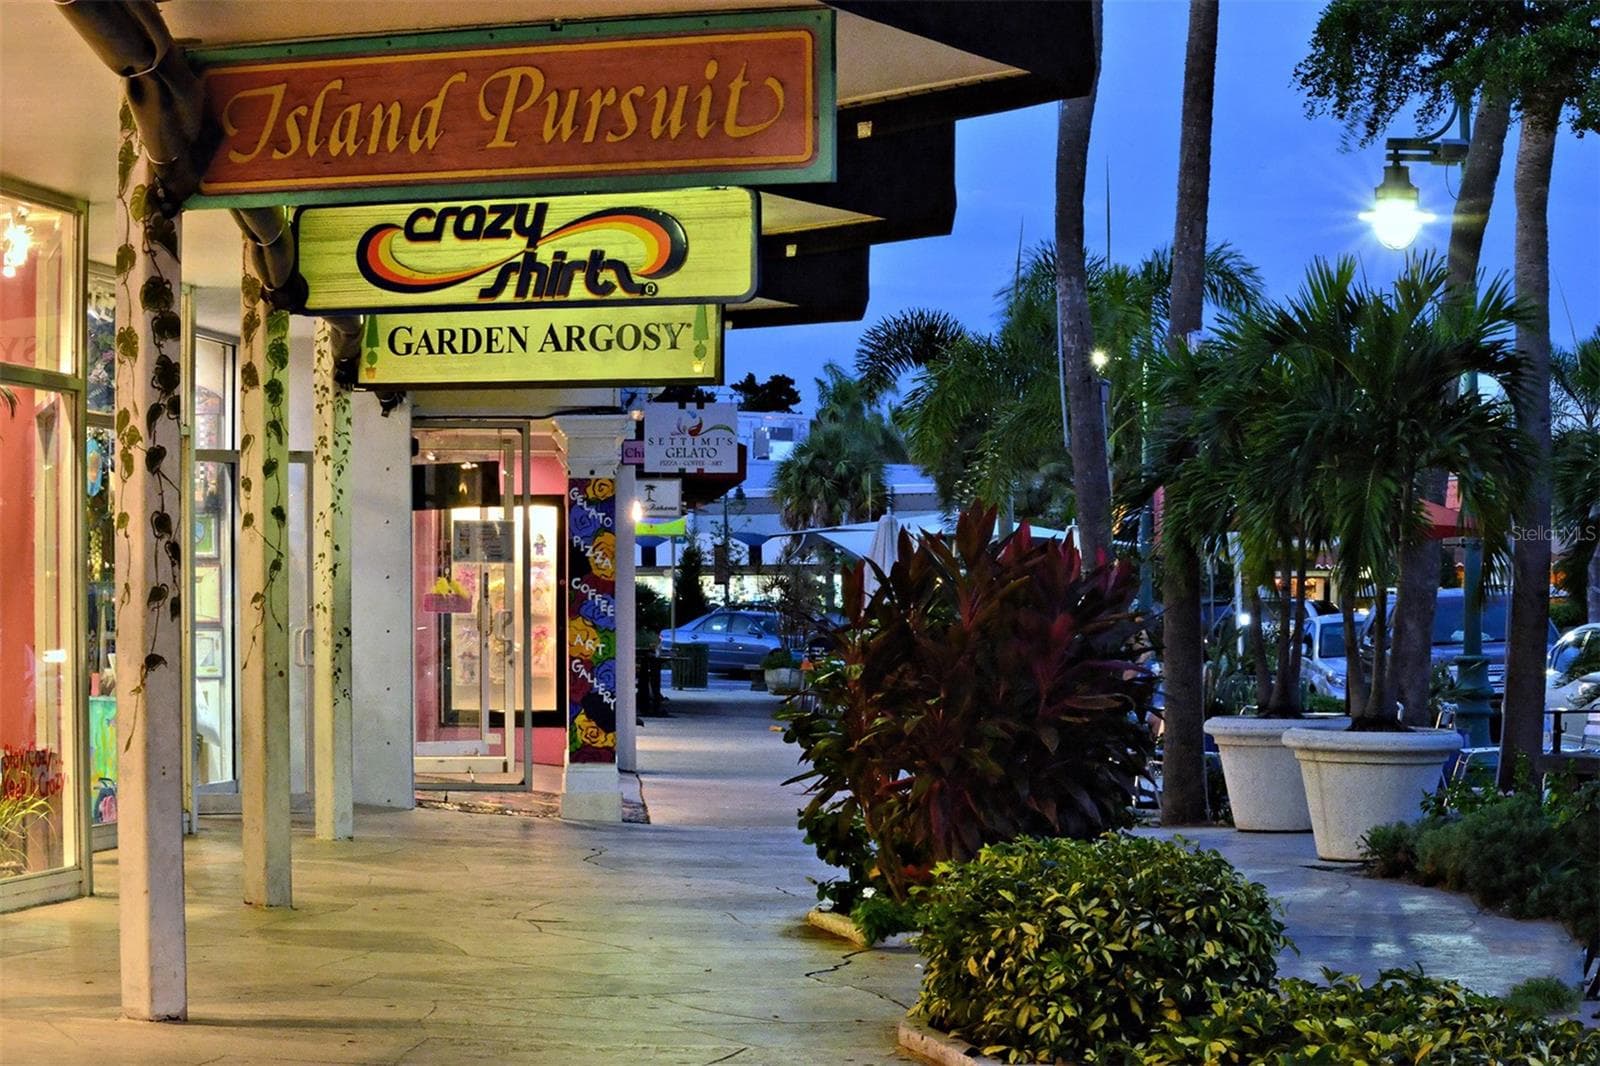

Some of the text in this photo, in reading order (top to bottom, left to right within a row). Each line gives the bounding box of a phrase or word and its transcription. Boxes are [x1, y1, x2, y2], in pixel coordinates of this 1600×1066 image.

[222, 59, 785, 164] Island Pursuit
[403, 202, 549, 249] crazy
[387, 322, 686, 357] GARDEN ARGOSY
[648, 437, 734, 446] SETTIMI'S
[665, 447, 718, 459] GELATO
[569, 487, 613, 528] GELATO
[573, 535, 613, 569] PIZZA
[571, 577, 615, 617] COFFEE
[574, 634, 606, 655] ART
[571, 659, 617, 710] GALLERY
